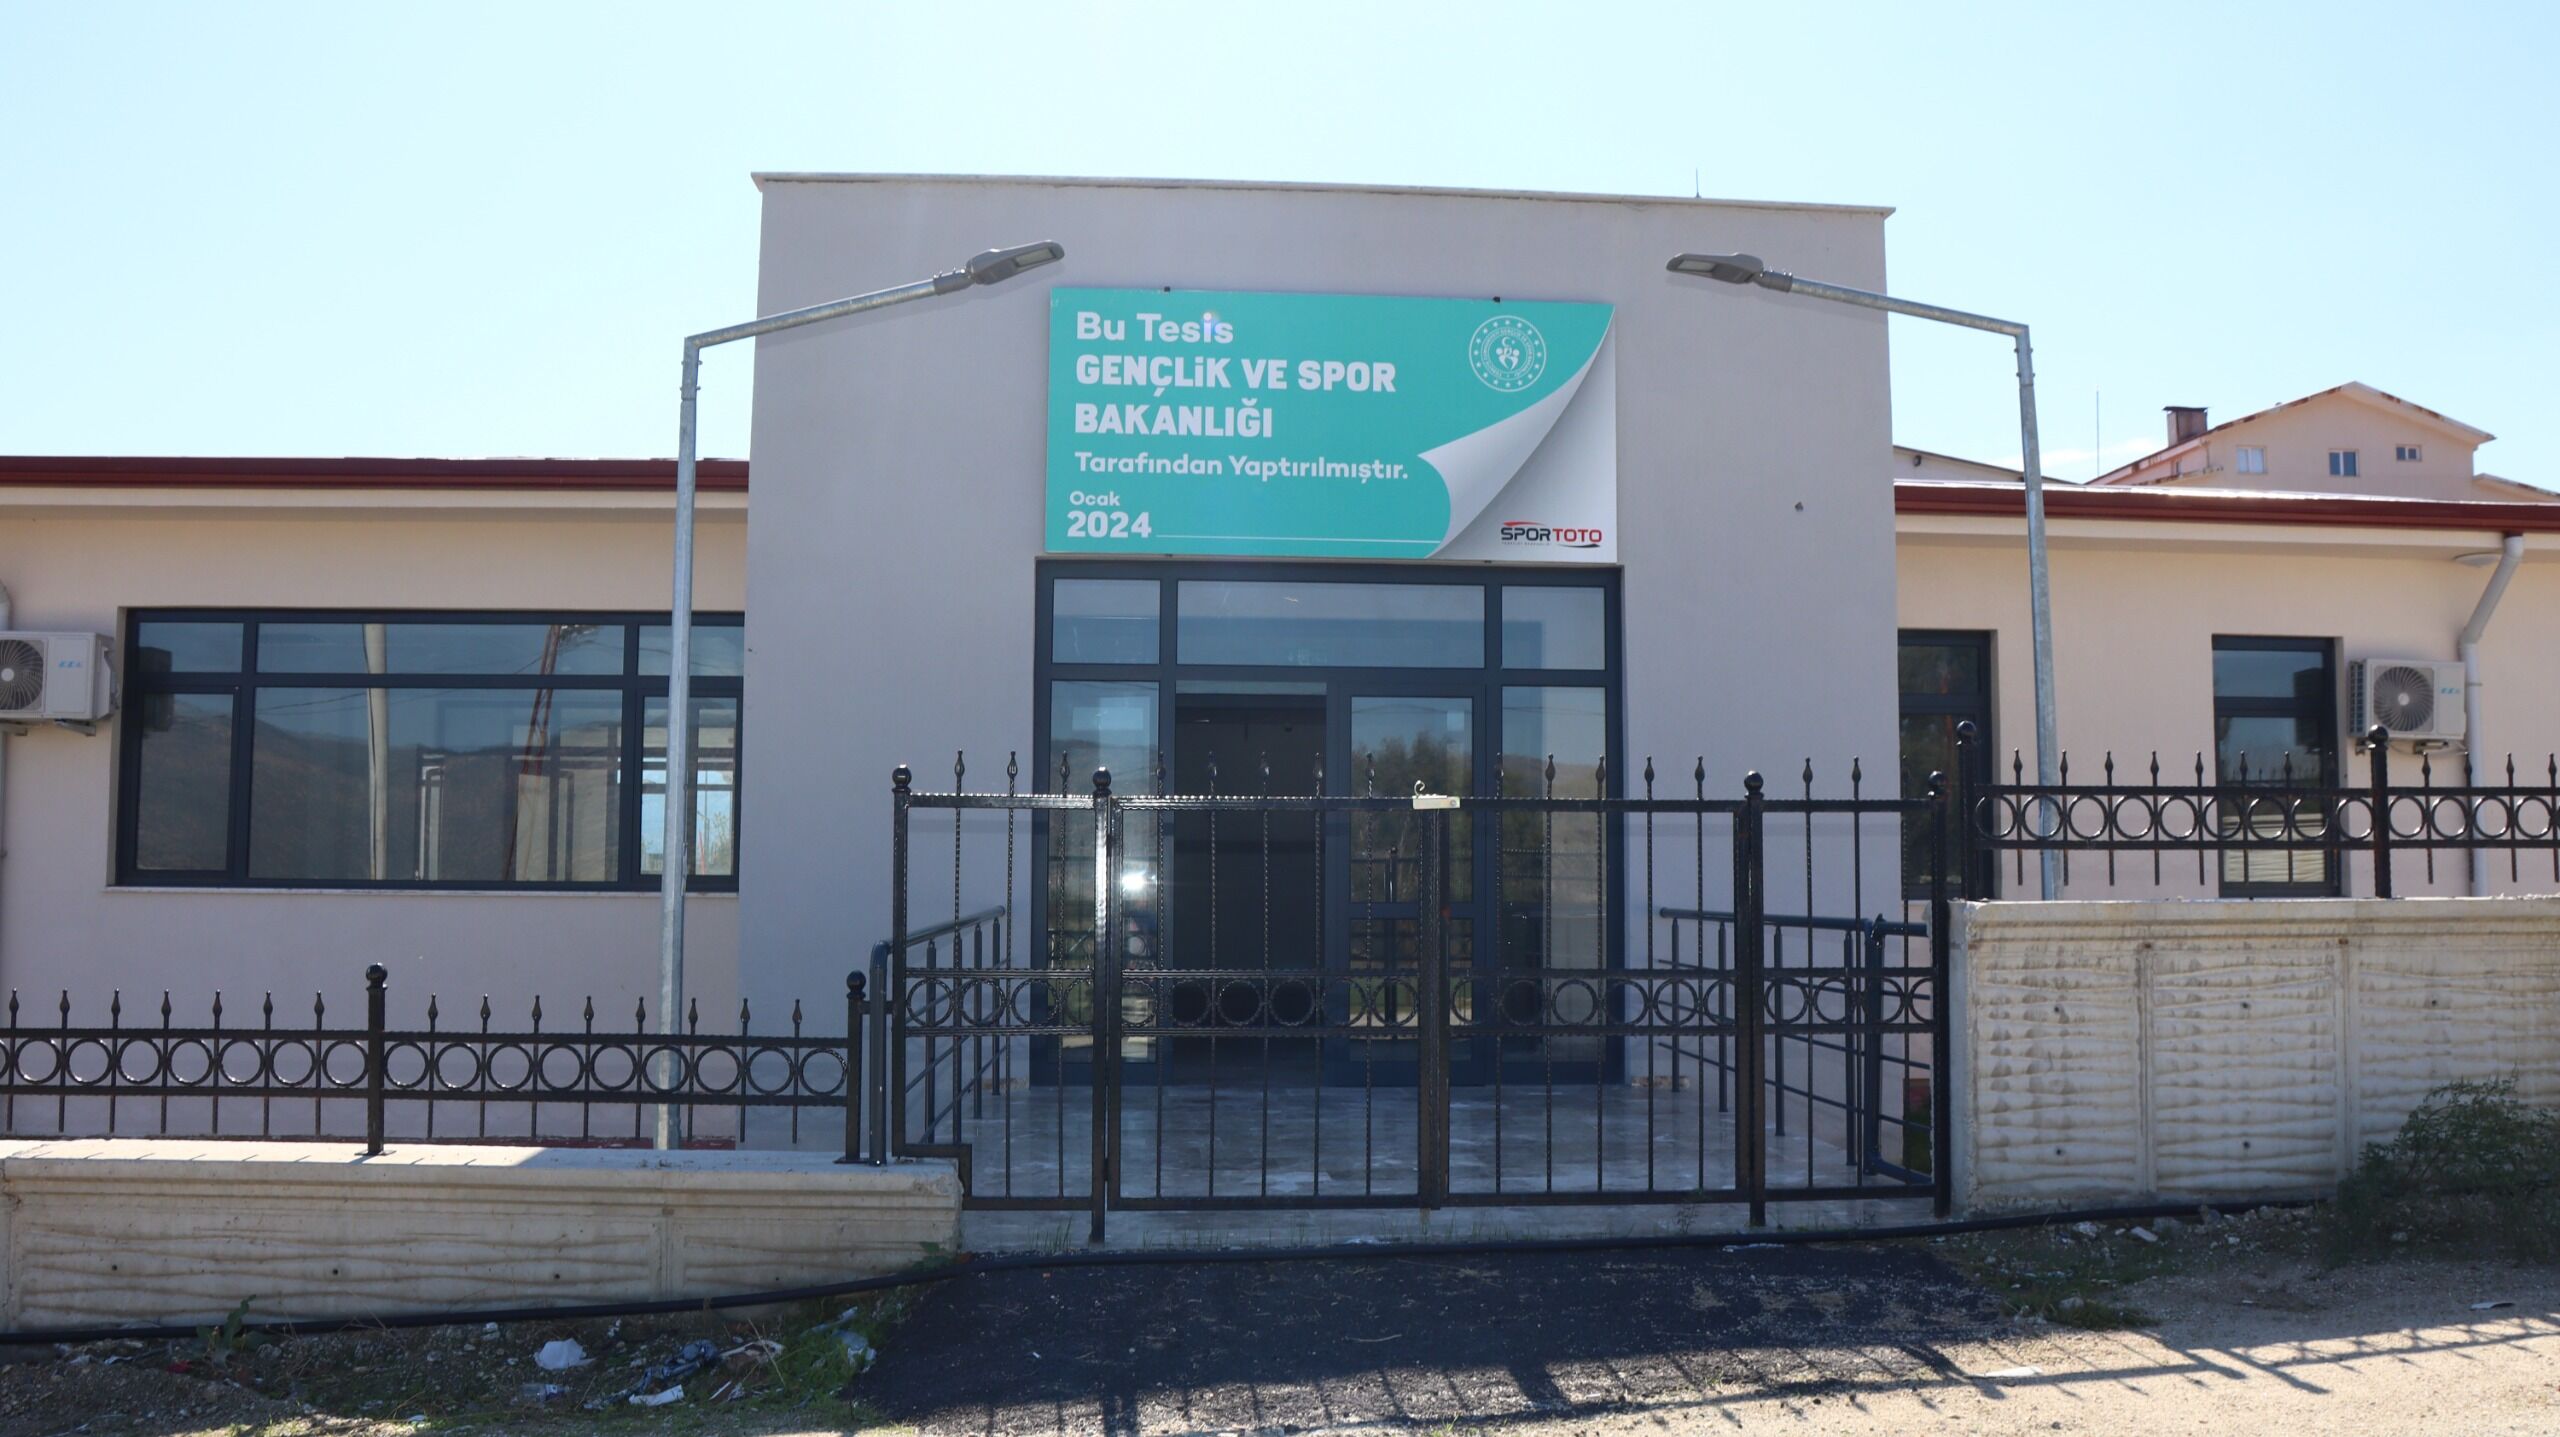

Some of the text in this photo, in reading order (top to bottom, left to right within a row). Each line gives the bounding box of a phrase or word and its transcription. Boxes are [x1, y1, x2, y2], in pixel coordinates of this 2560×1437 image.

[1076, 311, 1234, 344] Bu Tesis
[1241, 358, 1287, 390] VE
[1298, 360, 1396, 392] SPOR
[1075, 398, 1272, 438] BAKANLIĞI
[1074, 451, 1408, 484] Tarafından Yaptırılmıştır.
[1069, 490, 1120, 506] Ocak
[1067, 510, 1152, 538] 2024
